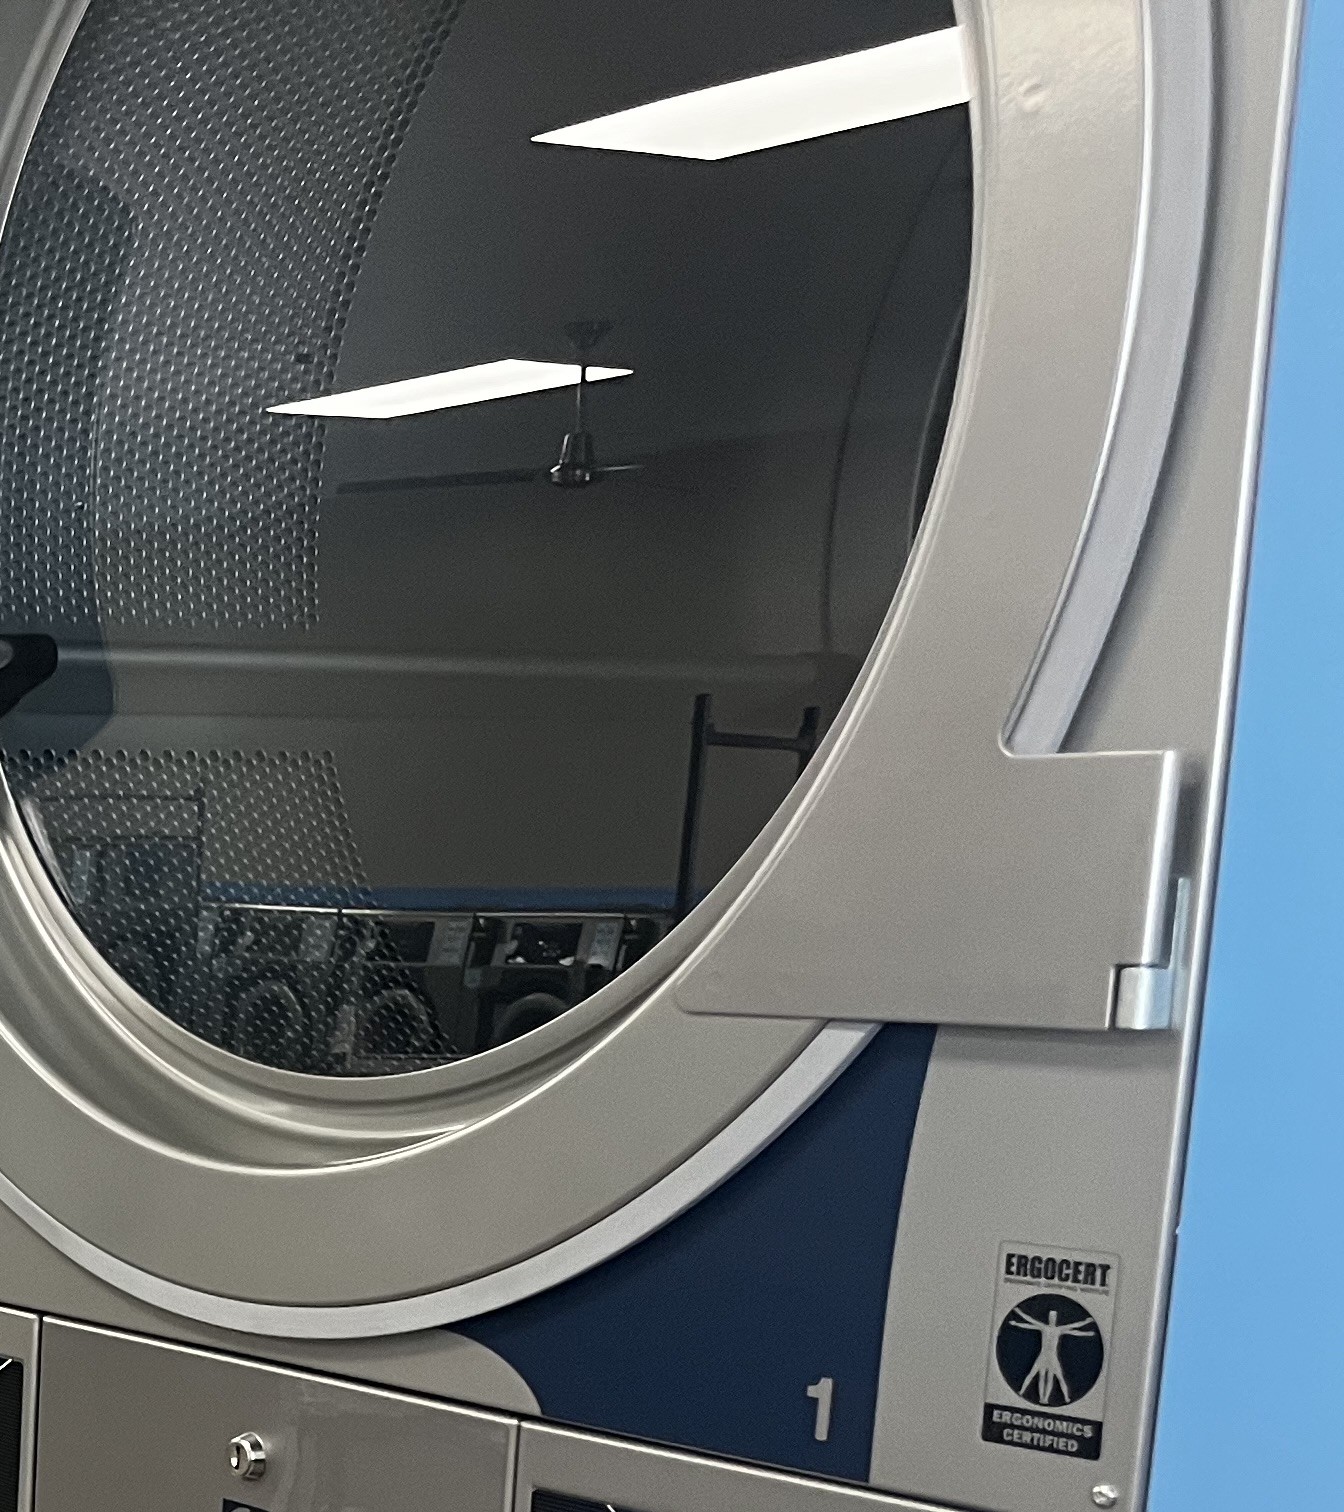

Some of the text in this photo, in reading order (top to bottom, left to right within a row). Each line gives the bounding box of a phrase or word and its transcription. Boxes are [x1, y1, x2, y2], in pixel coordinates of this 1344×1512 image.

[1004, 1252, 1112, 1288] ERGOCERT
[806, 1376, 833, 1442] 1
[991, 1409, 1093, 1439] ERGONOMICS
[1002, 1427, 1079, 1453] CERTIFIED
